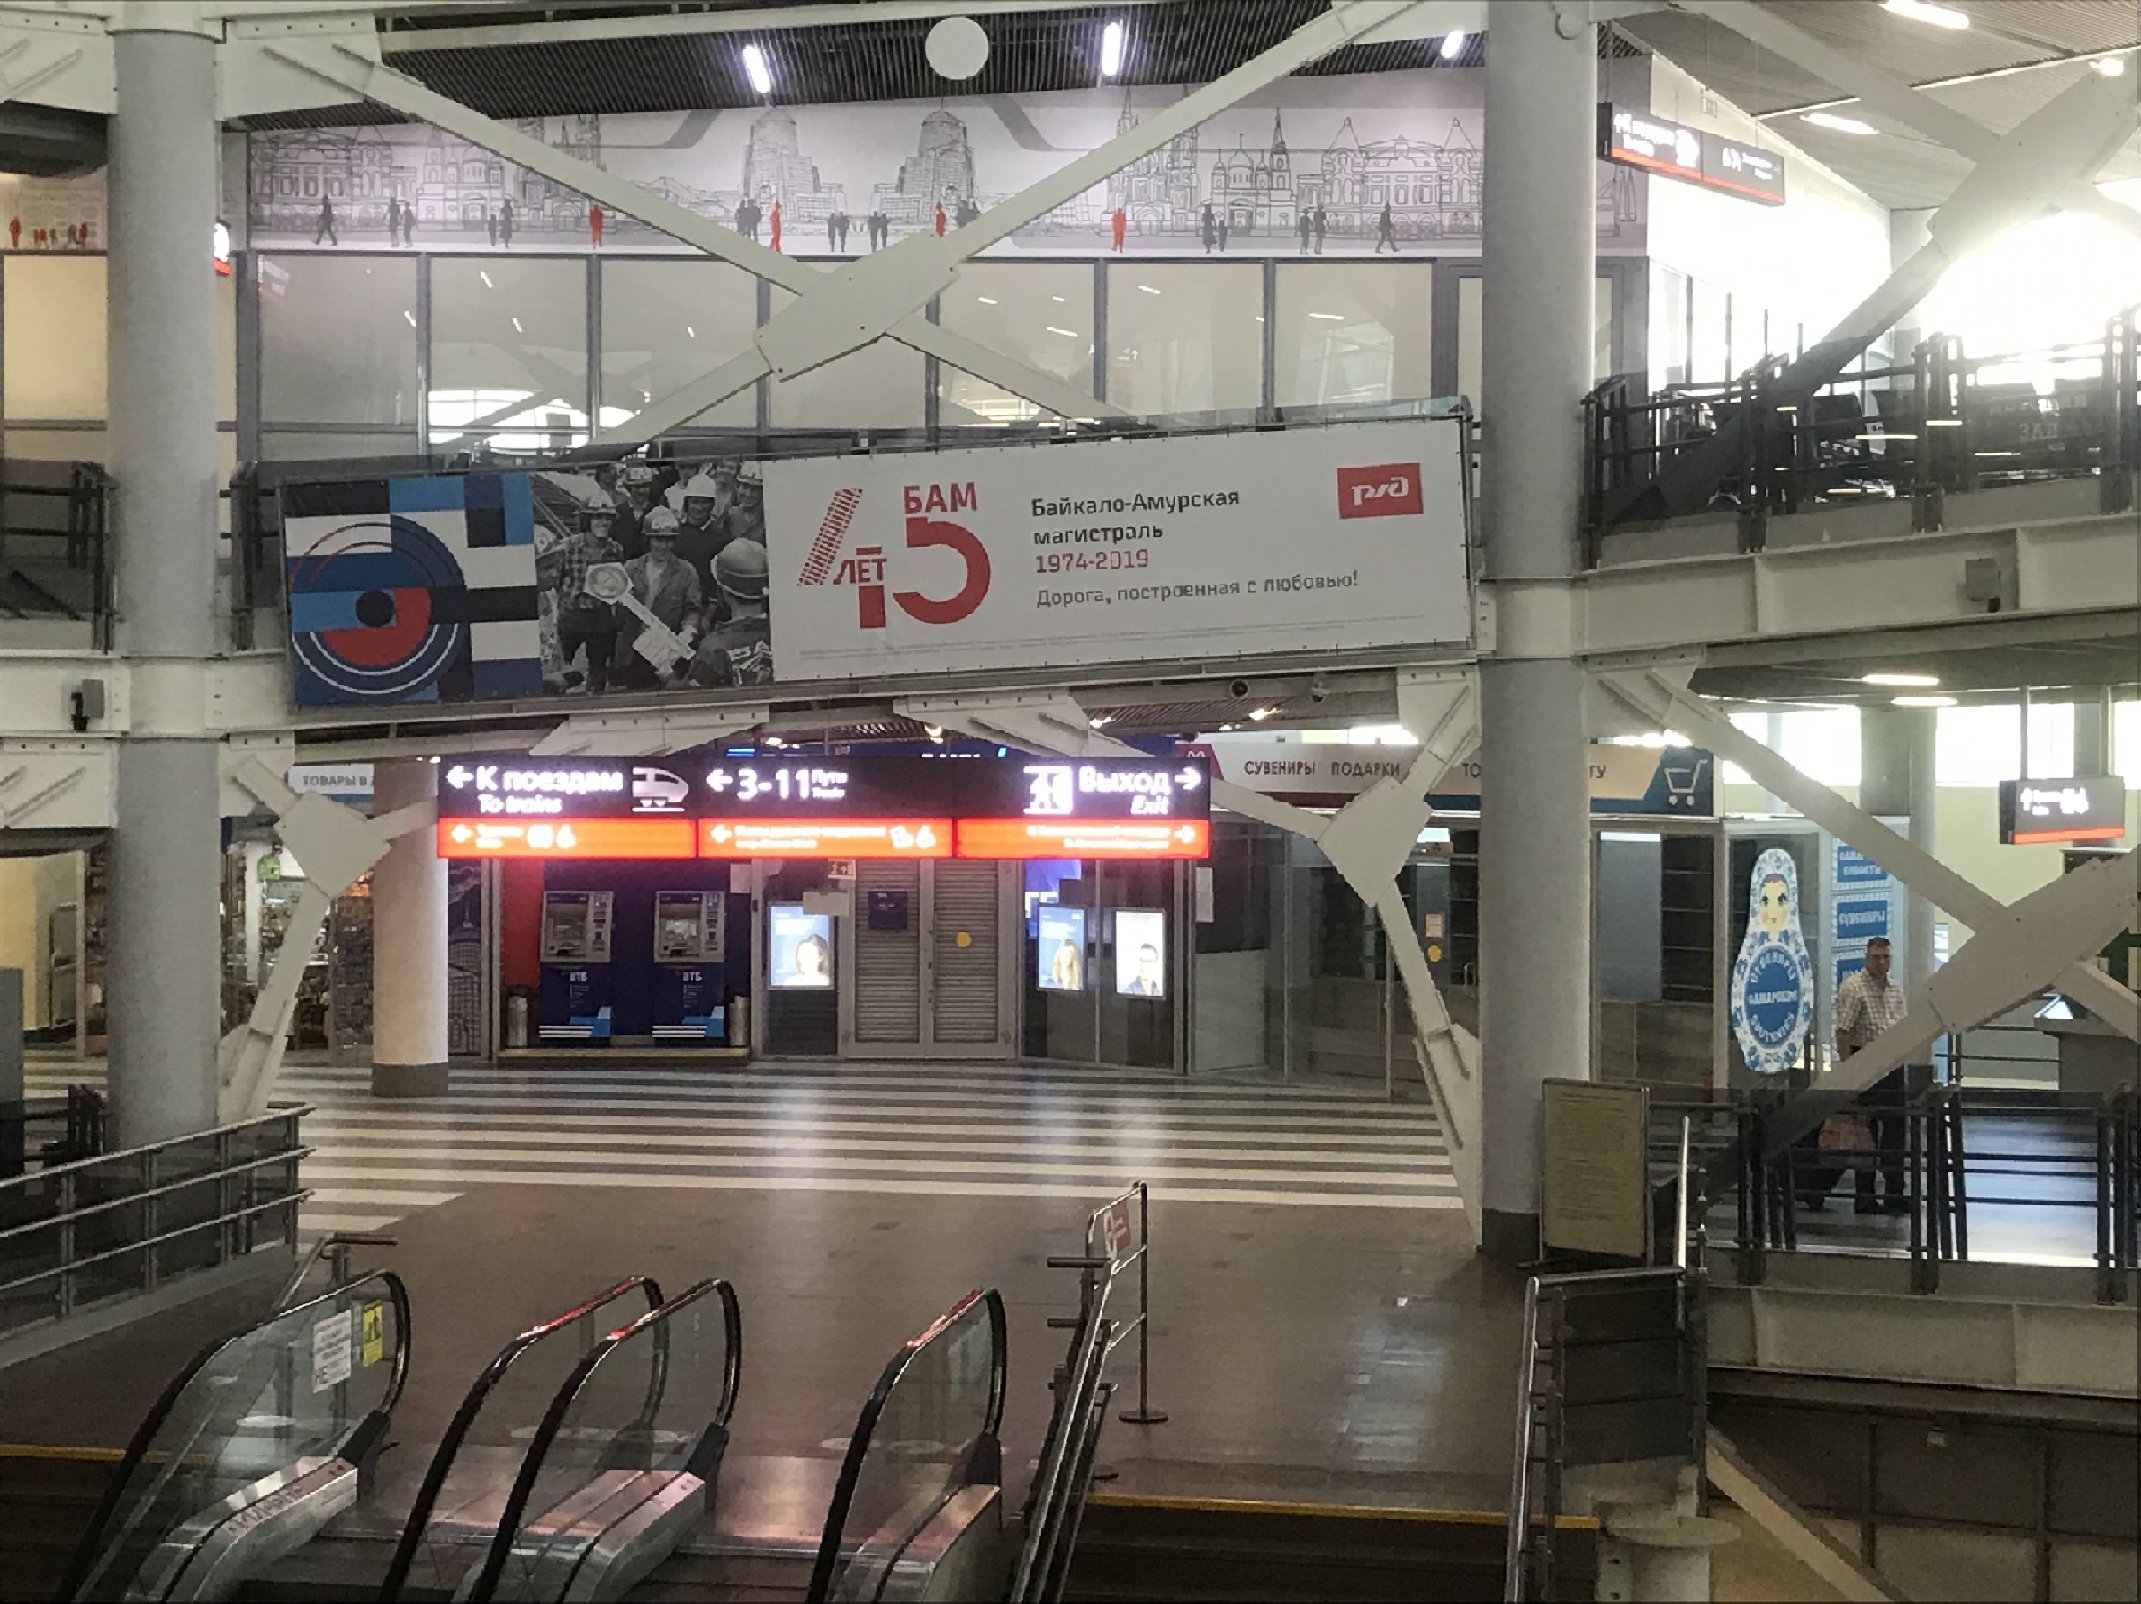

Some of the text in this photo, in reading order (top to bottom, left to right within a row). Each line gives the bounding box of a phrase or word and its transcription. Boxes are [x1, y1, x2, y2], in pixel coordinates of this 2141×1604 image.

[904, 481, 978, 514] БАМ
[1031, 491, 1241, 516] Байкало-Амурская
[1034, 525, 1164, 545] магистраль
[797, 487, 991, 629] 45
[1036, 549, 1149, 574] 1974-2019
[833, 558, 887, 585] ЛЕТ
[1037, 589, 1113, 608] Дорога,
[1117, 582, 1240, 601] построенная
[1263, 569, 1359, 593] любовью!
[303, 775, 356, 786] ТОВАРЫ
[476, 765, 499, 791] К
[1079, 766, 1171, 796] Выход
[1244, 760, 1315, 776] СУВЕНИРЫ
[1331, 761, 1400, 777] ПОДАРКИ
[737, 768, 809, 799] 3-11
[477, 794, 503, 813] To
[1131, 795, 1169, 815] Exit
